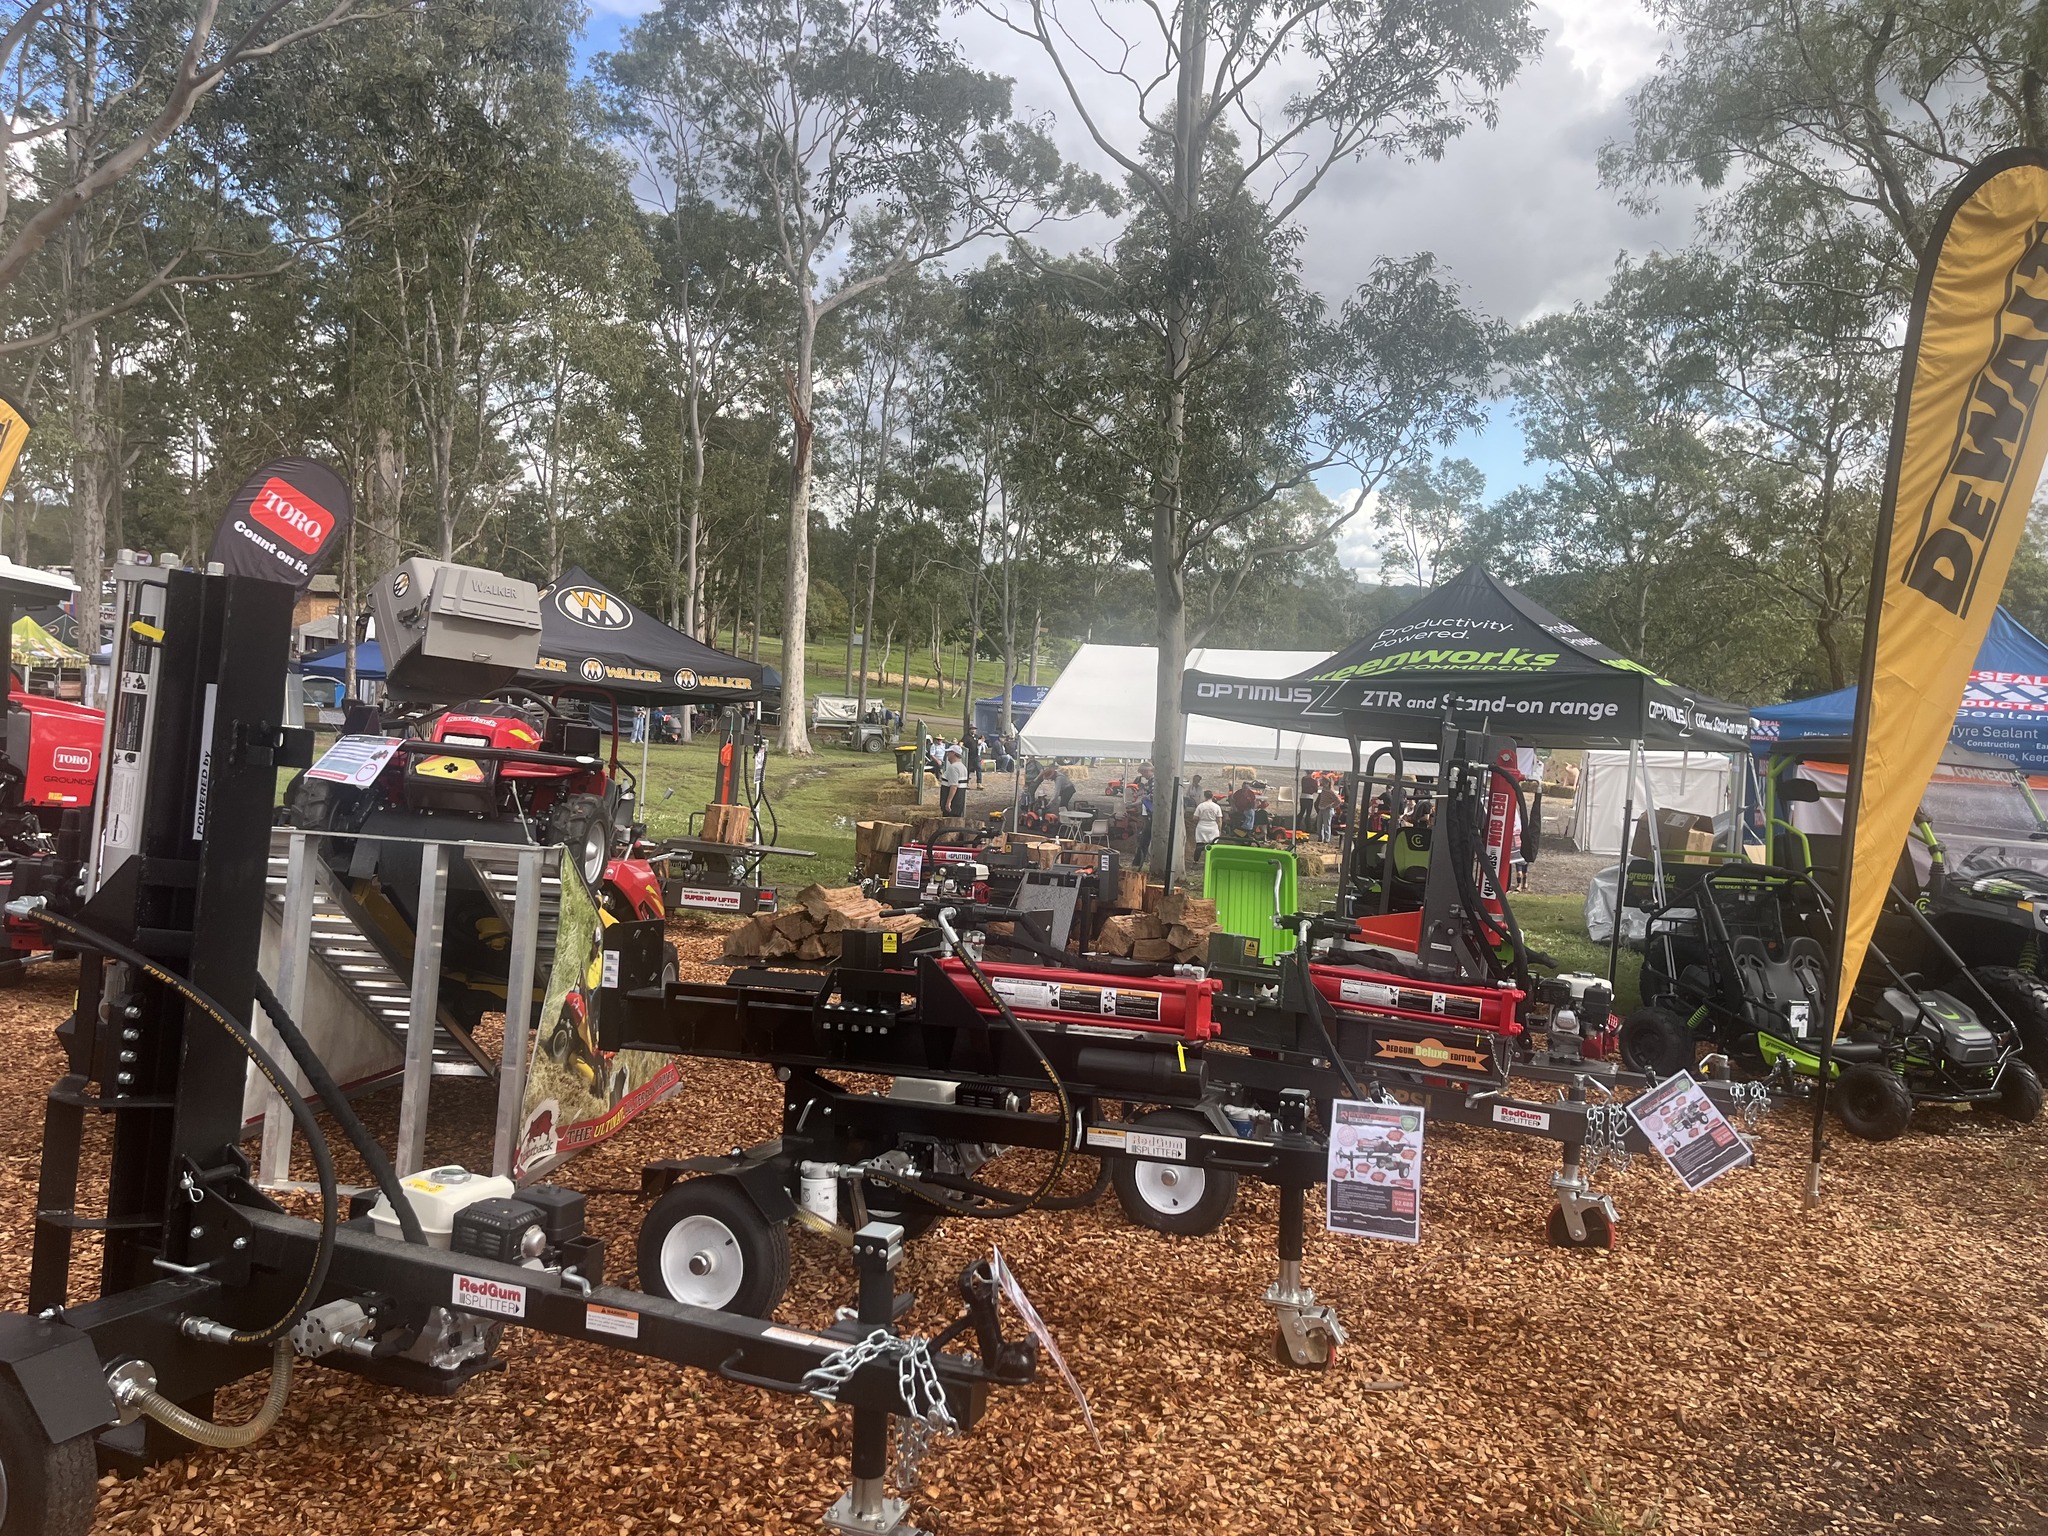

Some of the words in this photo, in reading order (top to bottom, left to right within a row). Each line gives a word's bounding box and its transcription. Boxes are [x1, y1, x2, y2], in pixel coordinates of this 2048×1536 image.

[262, 490, 322, 538] TORO
[233, 520, 277, 555] Count
[276, 550, 295, 567] on
[294, 559, 309, 577] it.
[471, 579, 517, 599] WALKER
[1377, 617, 1515, 640] Productivity.
[1369, 629, 1470, 652] Powered.
[604, 666, 662, 683] WALKER
[1307, 648, 1560, 681] reenworks
[1400, 664, 1549, 672] COMMERCIAL
[698, 675, 753, 690] WALKER
[1197, 682, 1313, 703] OPTIMUS
[1360, 690, 1403, 708] ZTR
[1406, 697, 1437, 710] and
[1549, 700, 1619, 721] range
[1952, 725, 1979, 738] Tyre
[1982, 726, 2039, 739] Sealant
[1966, 739, 2020, 749] Construction
[57, 753, 88, 765] TORO
[196, 769, 209, 835] POWERED
[203, 750, 212, 766] by
[1488, 820, 1504, 847] GUM
[143, 963, 174, 985] FUDE
[177, 984, 209, 1011] HYDRAULIC
[209, 1008, 224, 1025] HOSE
[1414, 1045, 1449, 1060] Deluxe
[1450, 1053, 1477, 1063] EDITION
[1501, 1108, 1541, 1120] RedGum
[1504, 1116, 1539, 1127] SPLITTER
[567, 1126, 593, 1145] THE
[1133, 1135, 1183, 1149] RedGum
[1135, 1145, 1178, 1158] SPLITTER
[459, 1277, 521, 1303] RedGum
[465, 1293, 515, 1315] SPLITTER
